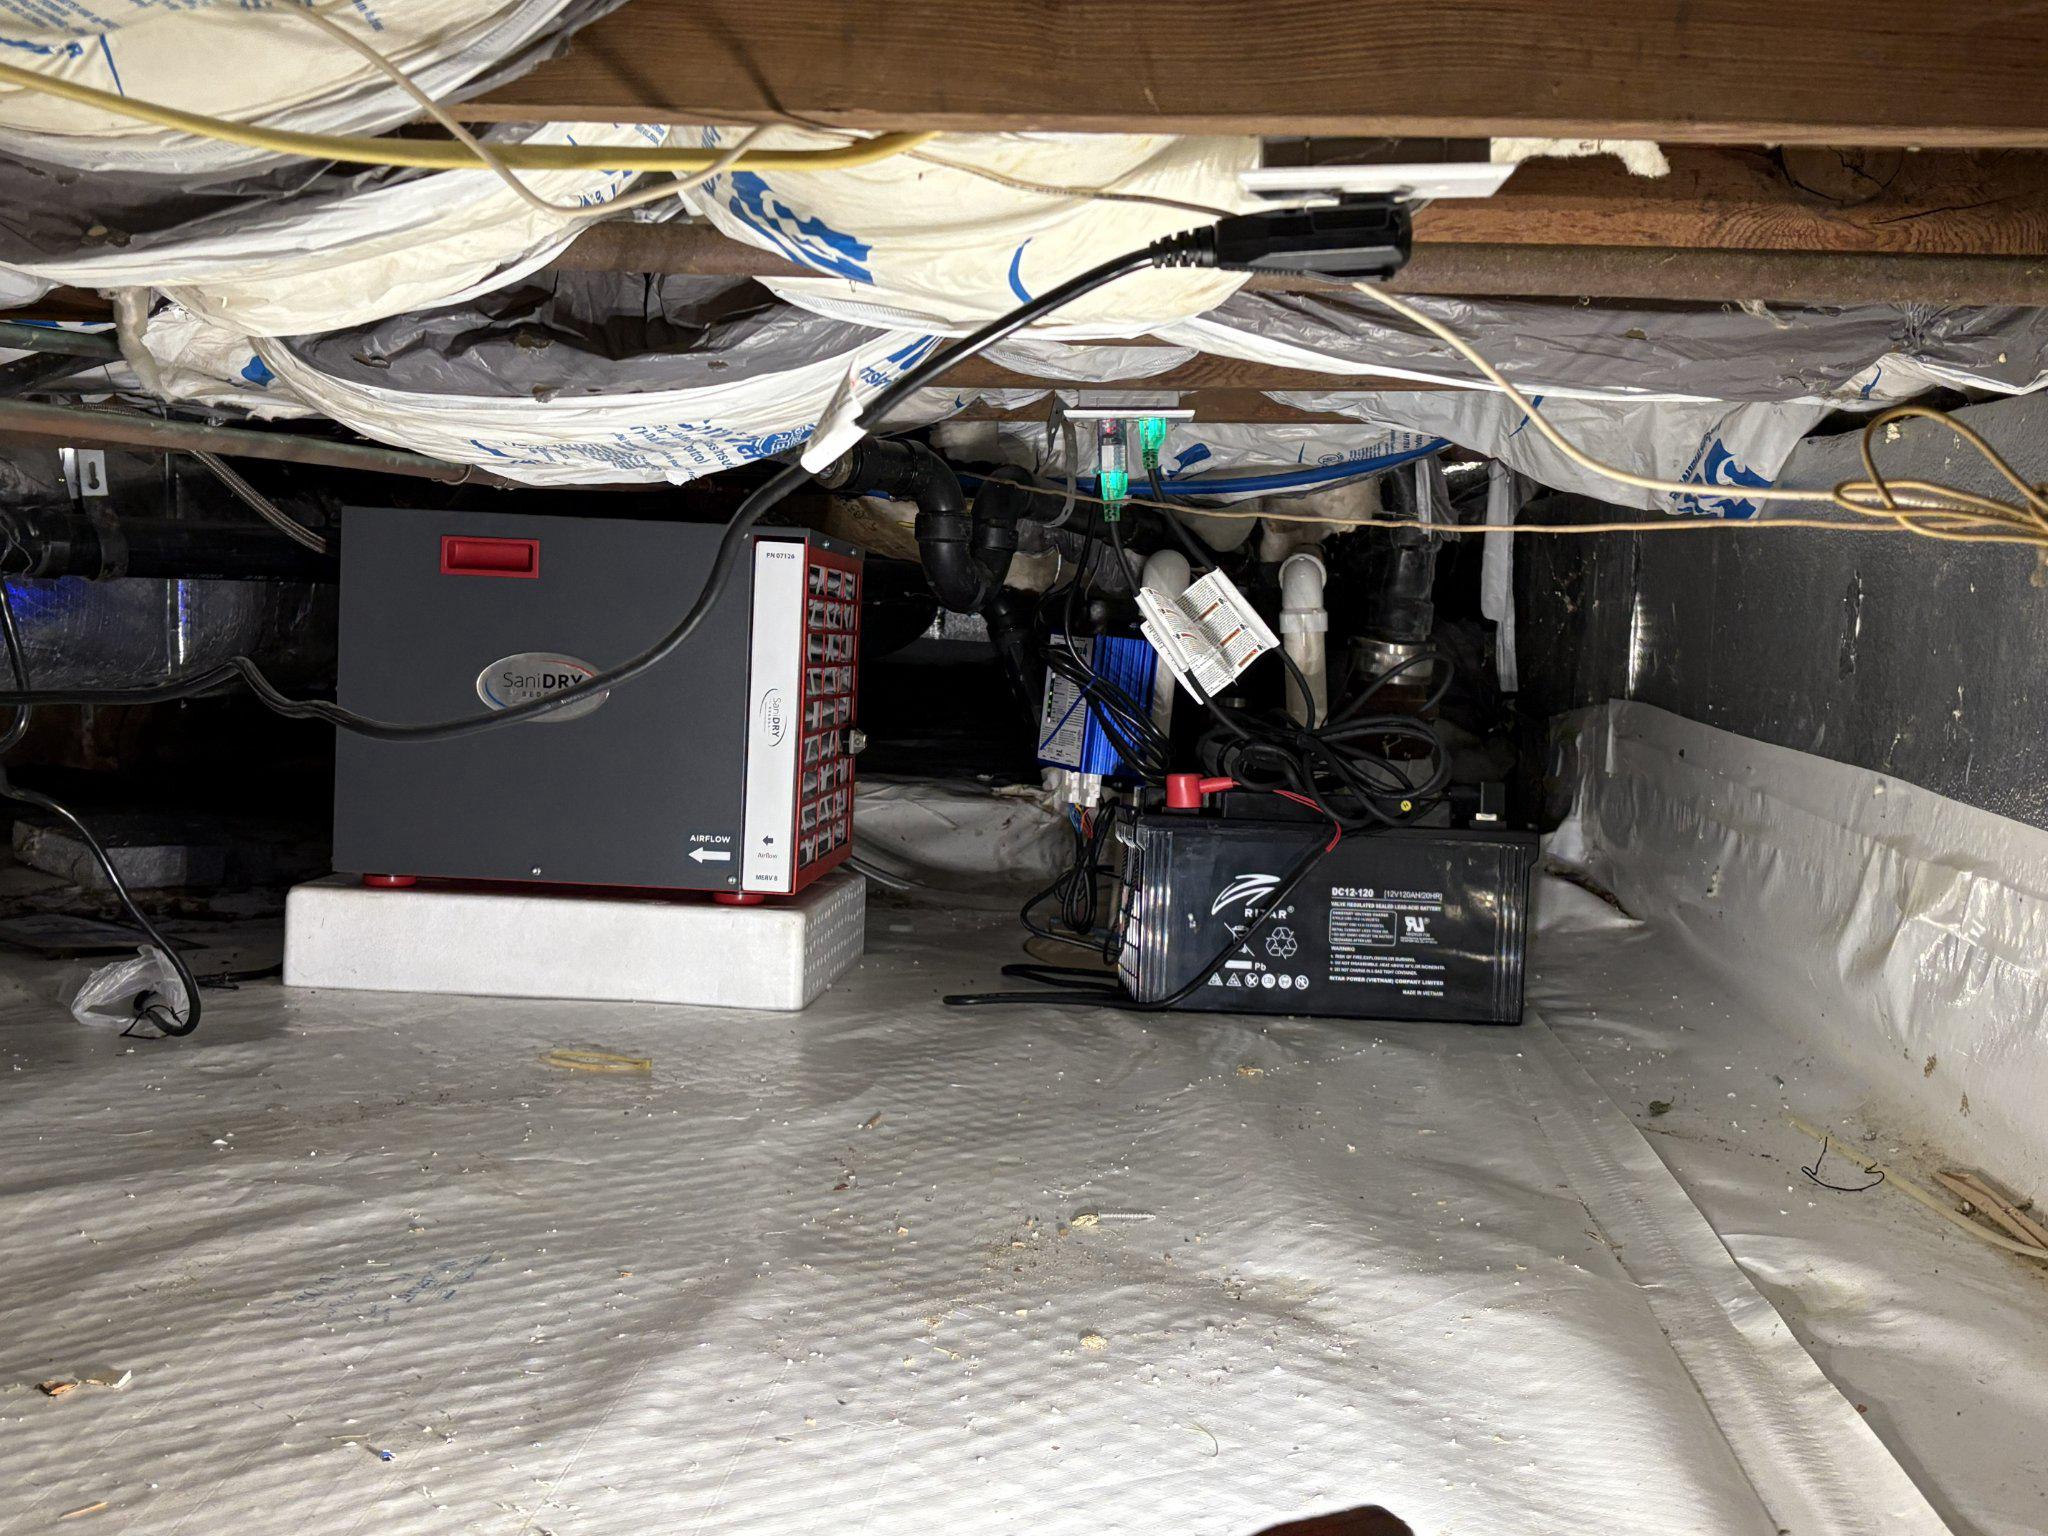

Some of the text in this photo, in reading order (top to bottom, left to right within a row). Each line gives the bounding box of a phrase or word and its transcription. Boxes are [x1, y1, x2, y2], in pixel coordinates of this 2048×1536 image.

[503, 671, 582, 689] SaniDRY
[772, 698, 781, 738] SaniDRY
[690, 834, 731, 843] AIRFLOW
[1331, 887, 1374, 897] DC12-120
[1254, 962, 1266, 971] Pb
